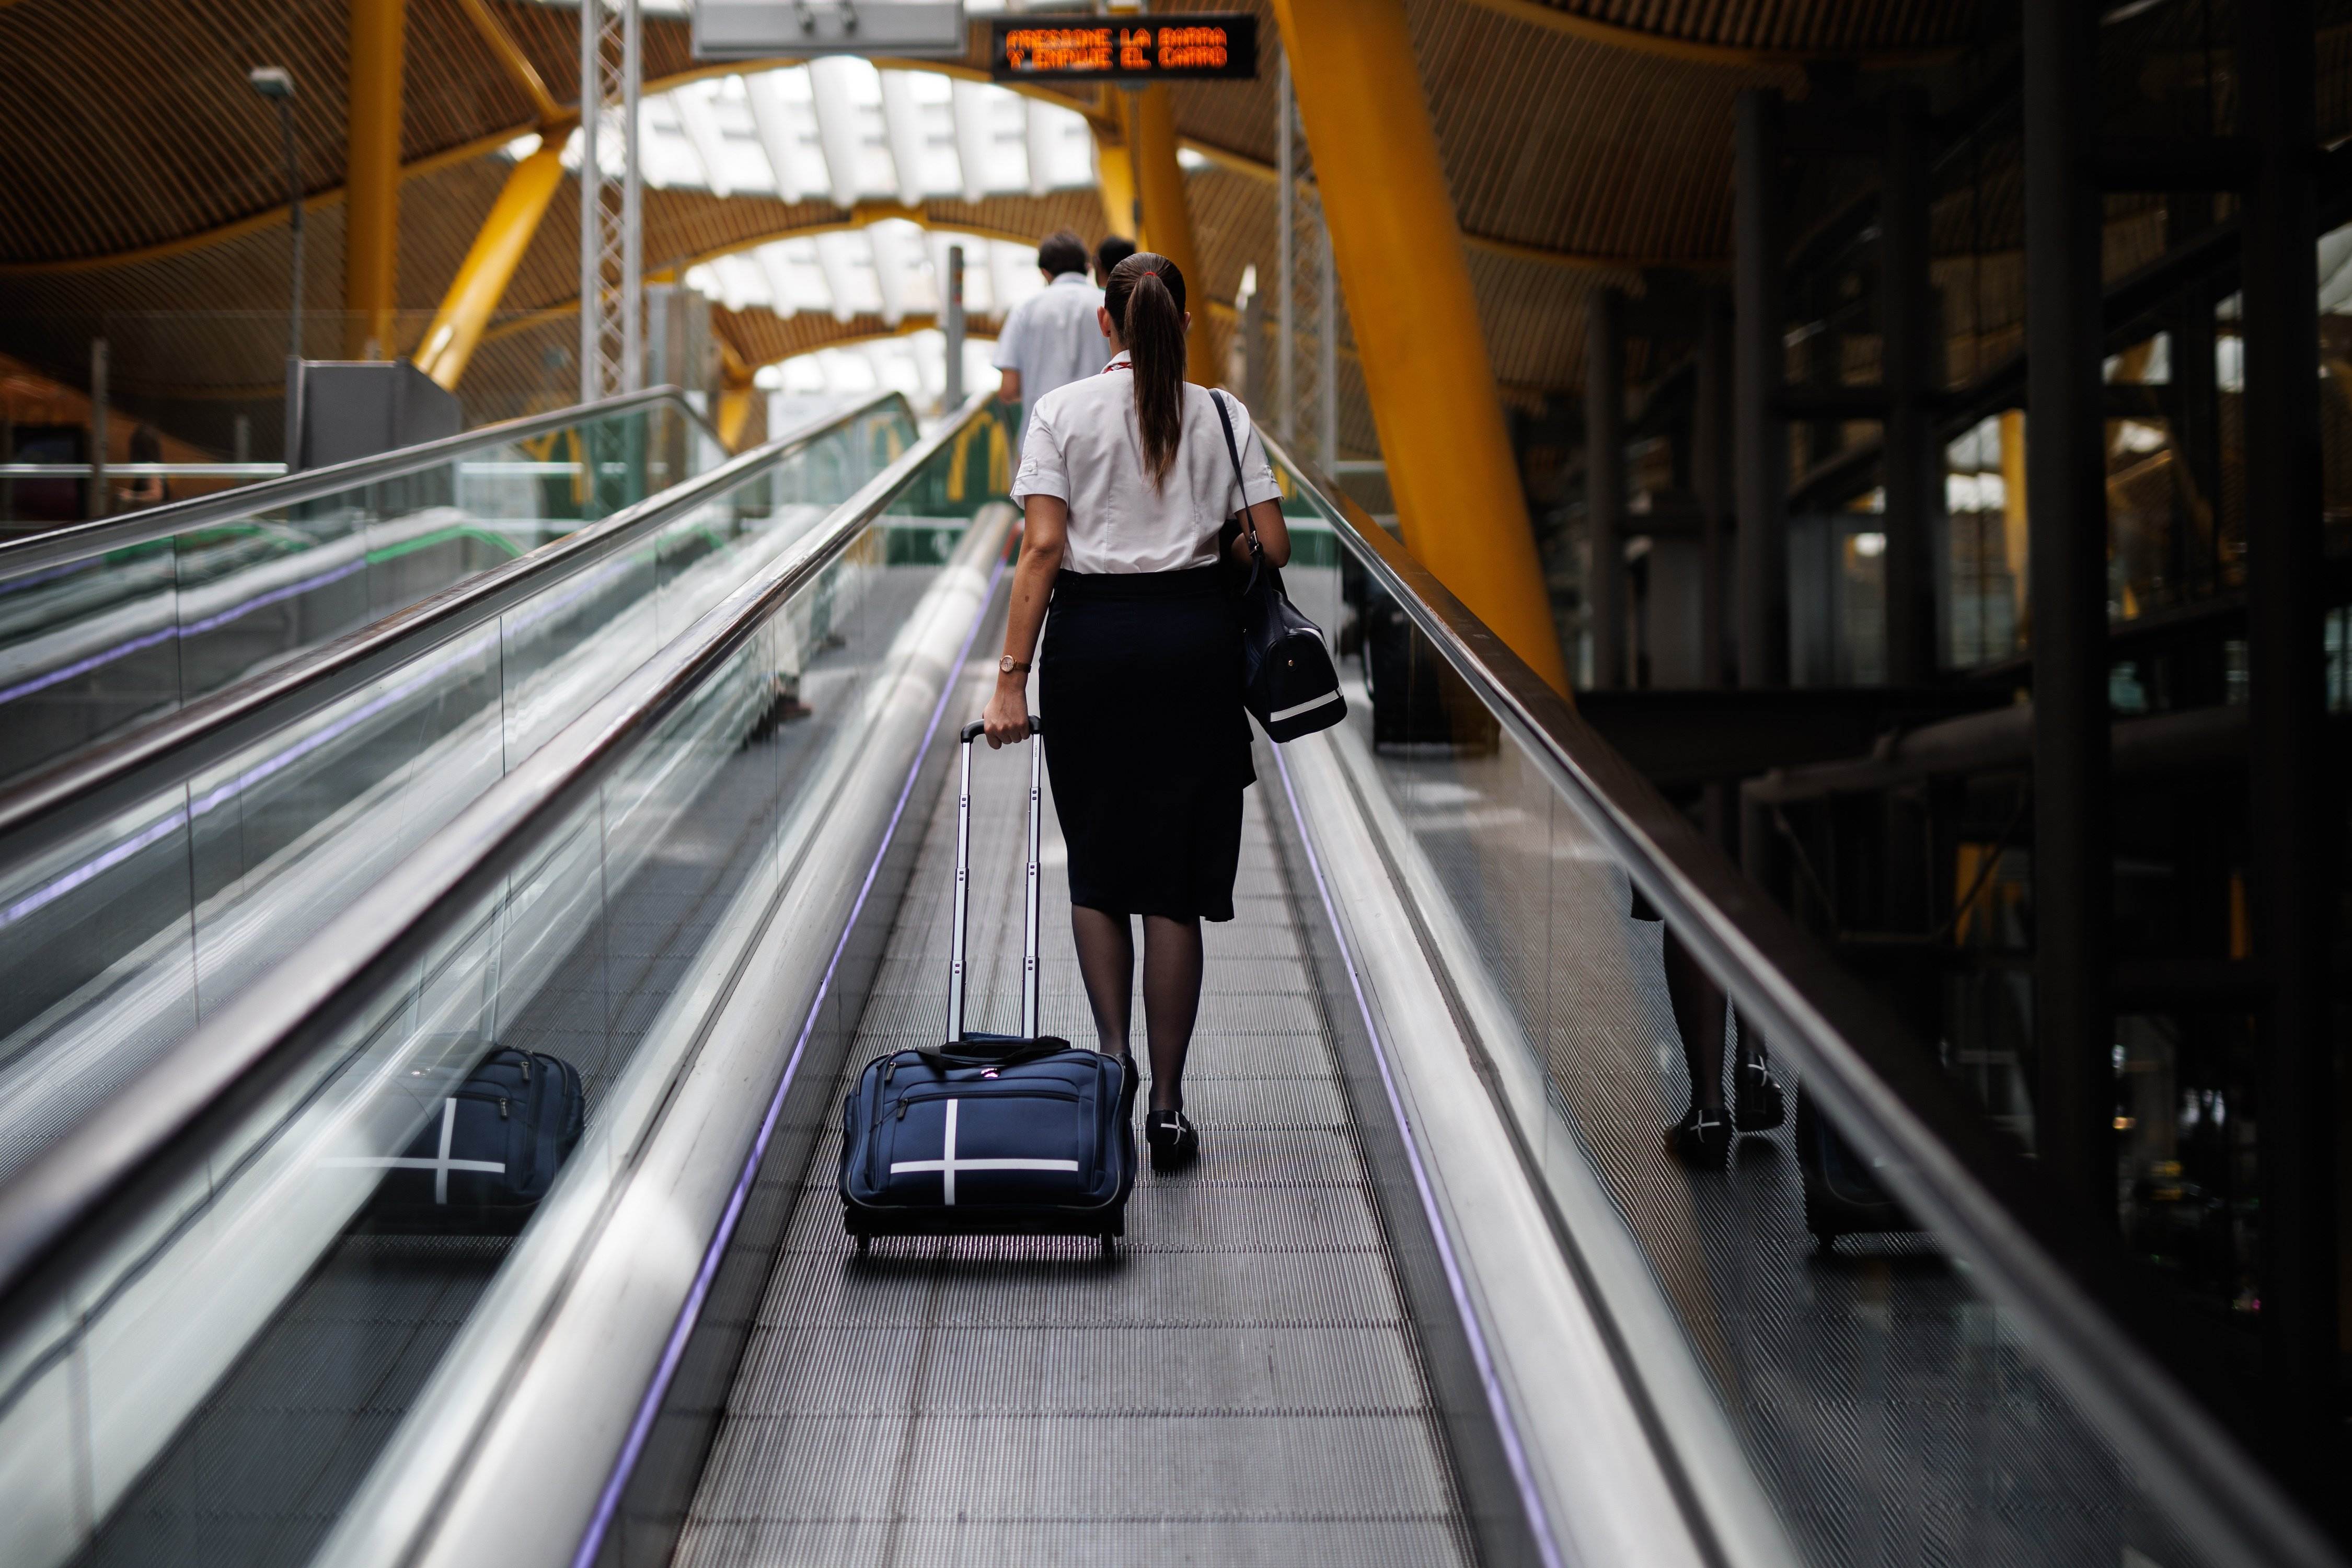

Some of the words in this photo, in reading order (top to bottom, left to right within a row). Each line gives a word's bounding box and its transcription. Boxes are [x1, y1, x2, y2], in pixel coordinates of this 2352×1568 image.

[1121, 29, 1151, 48] LA
[1007, 49, 1024, 71] Y
[1121, 48, 1151, 68] EL
